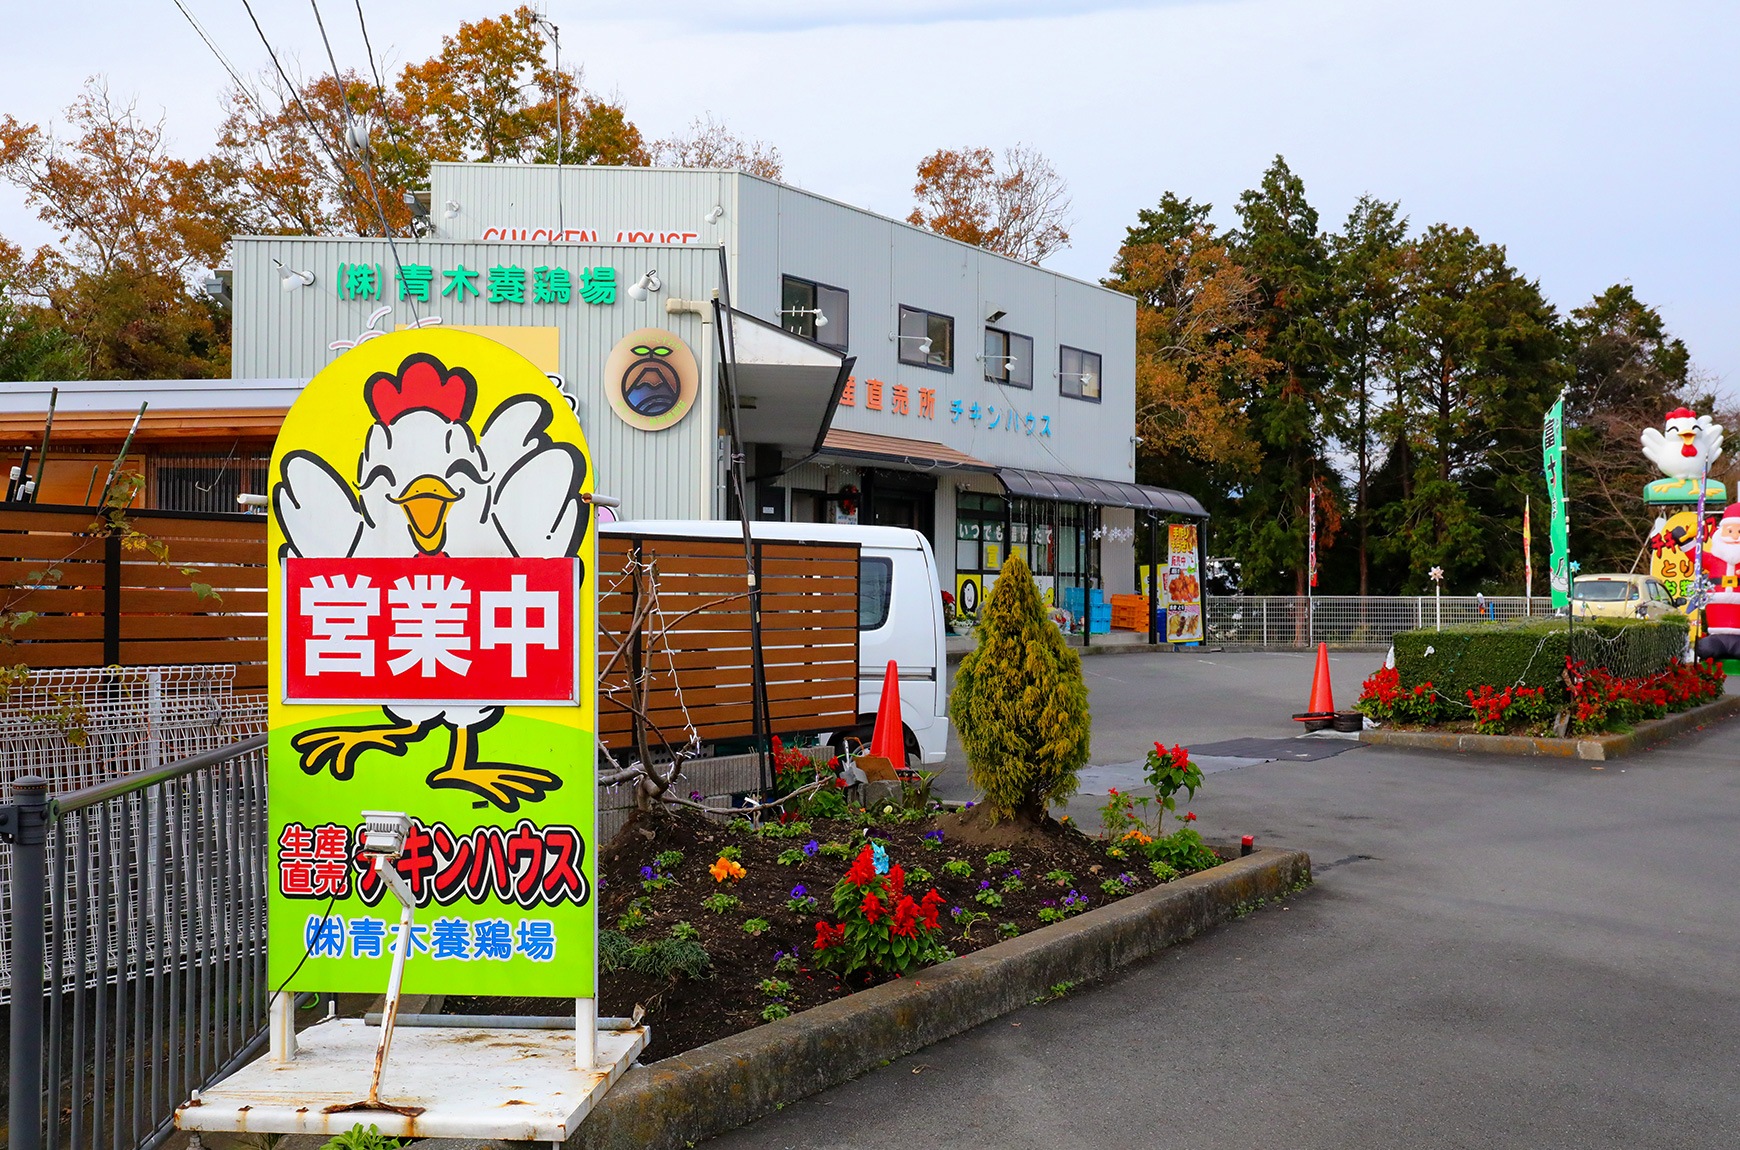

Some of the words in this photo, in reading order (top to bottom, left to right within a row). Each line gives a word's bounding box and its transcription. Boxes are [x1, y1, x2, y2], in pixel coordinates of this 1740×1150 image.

[337, 262, 617, 305] (株)青木養鶏場
[950, 400, 1052, 437] チキンハウス
[300, 574, 559, 677] 営業中
[281, 825, 348, 859] 生産
[281, 860, 348, 895] 直売
